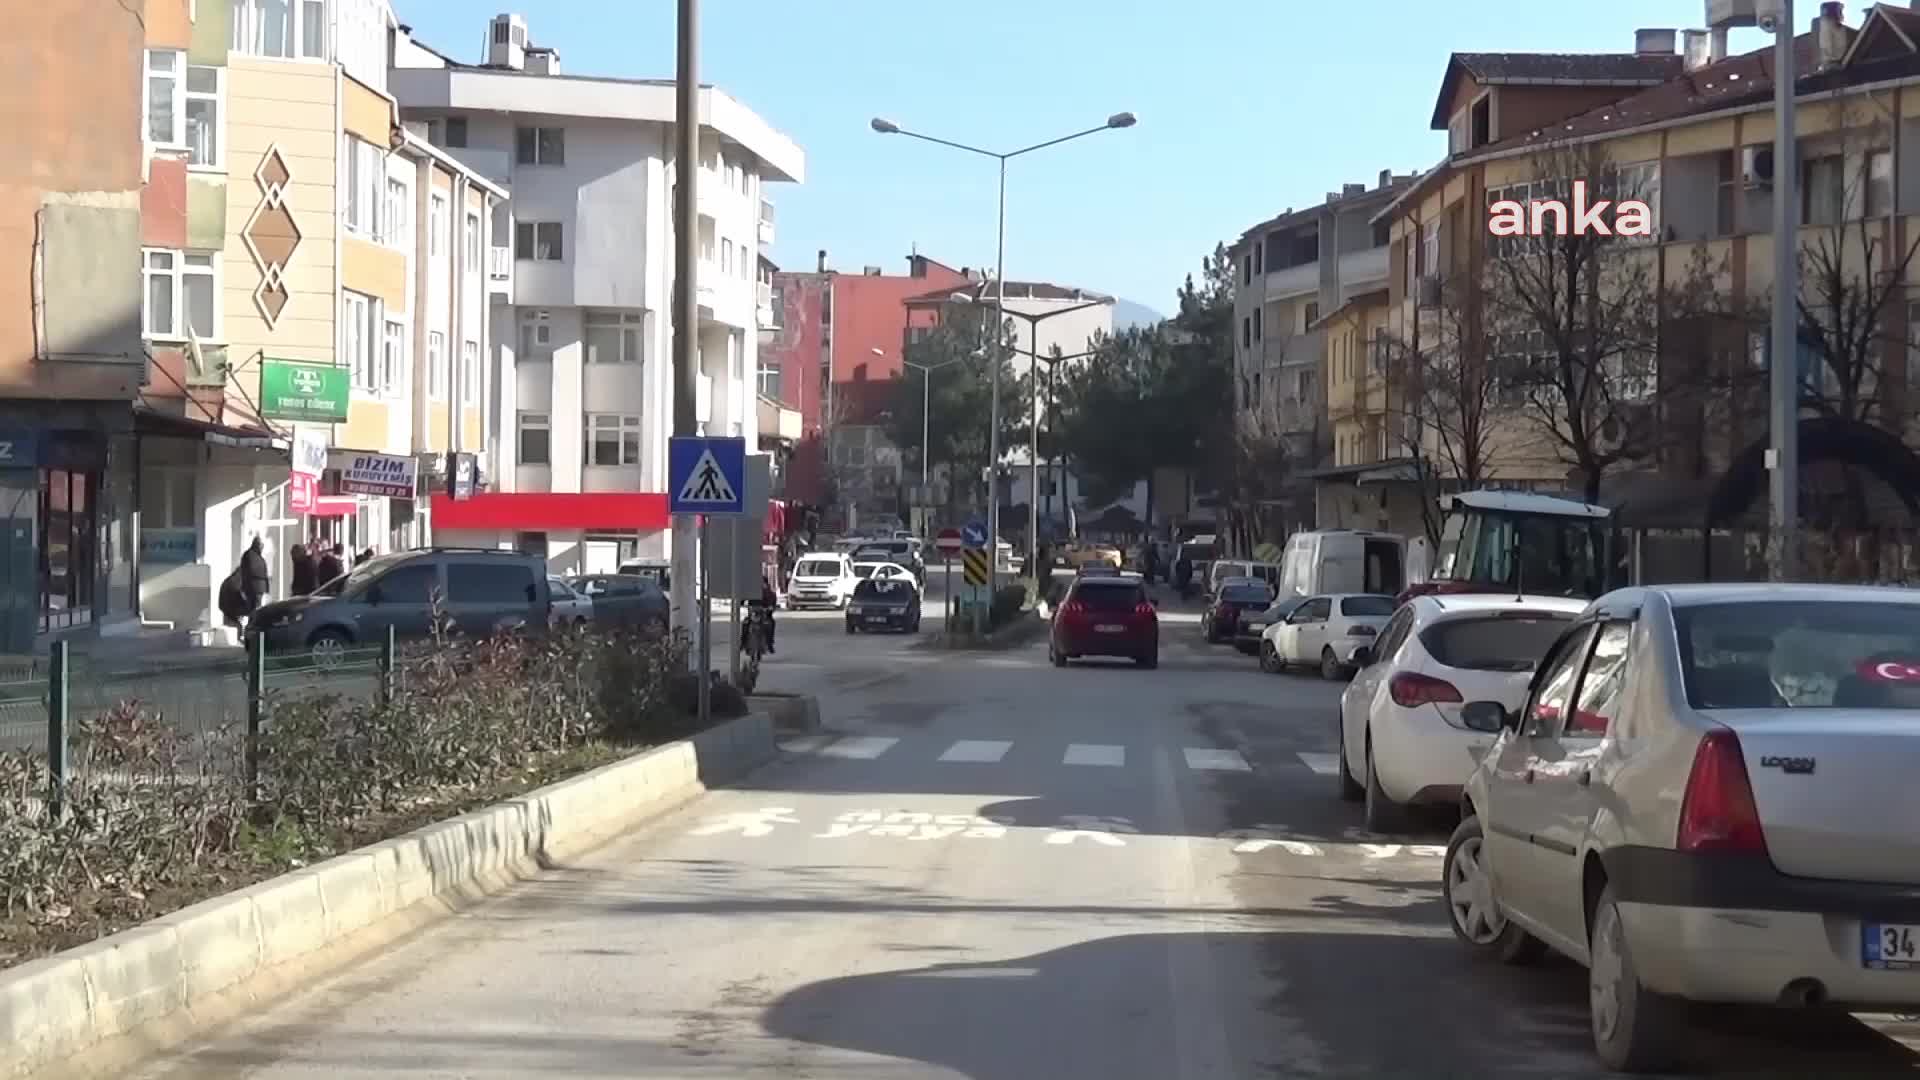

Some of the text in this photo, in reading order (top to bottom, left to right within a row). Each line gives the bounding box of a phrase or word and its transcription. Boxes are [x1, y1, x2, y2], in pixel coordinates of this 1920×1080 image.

[354, 456, 405, 473] BİZİM
[1760, 755, 1816, 771] LOGAN
[1884, 928, 1915, 957] 34
